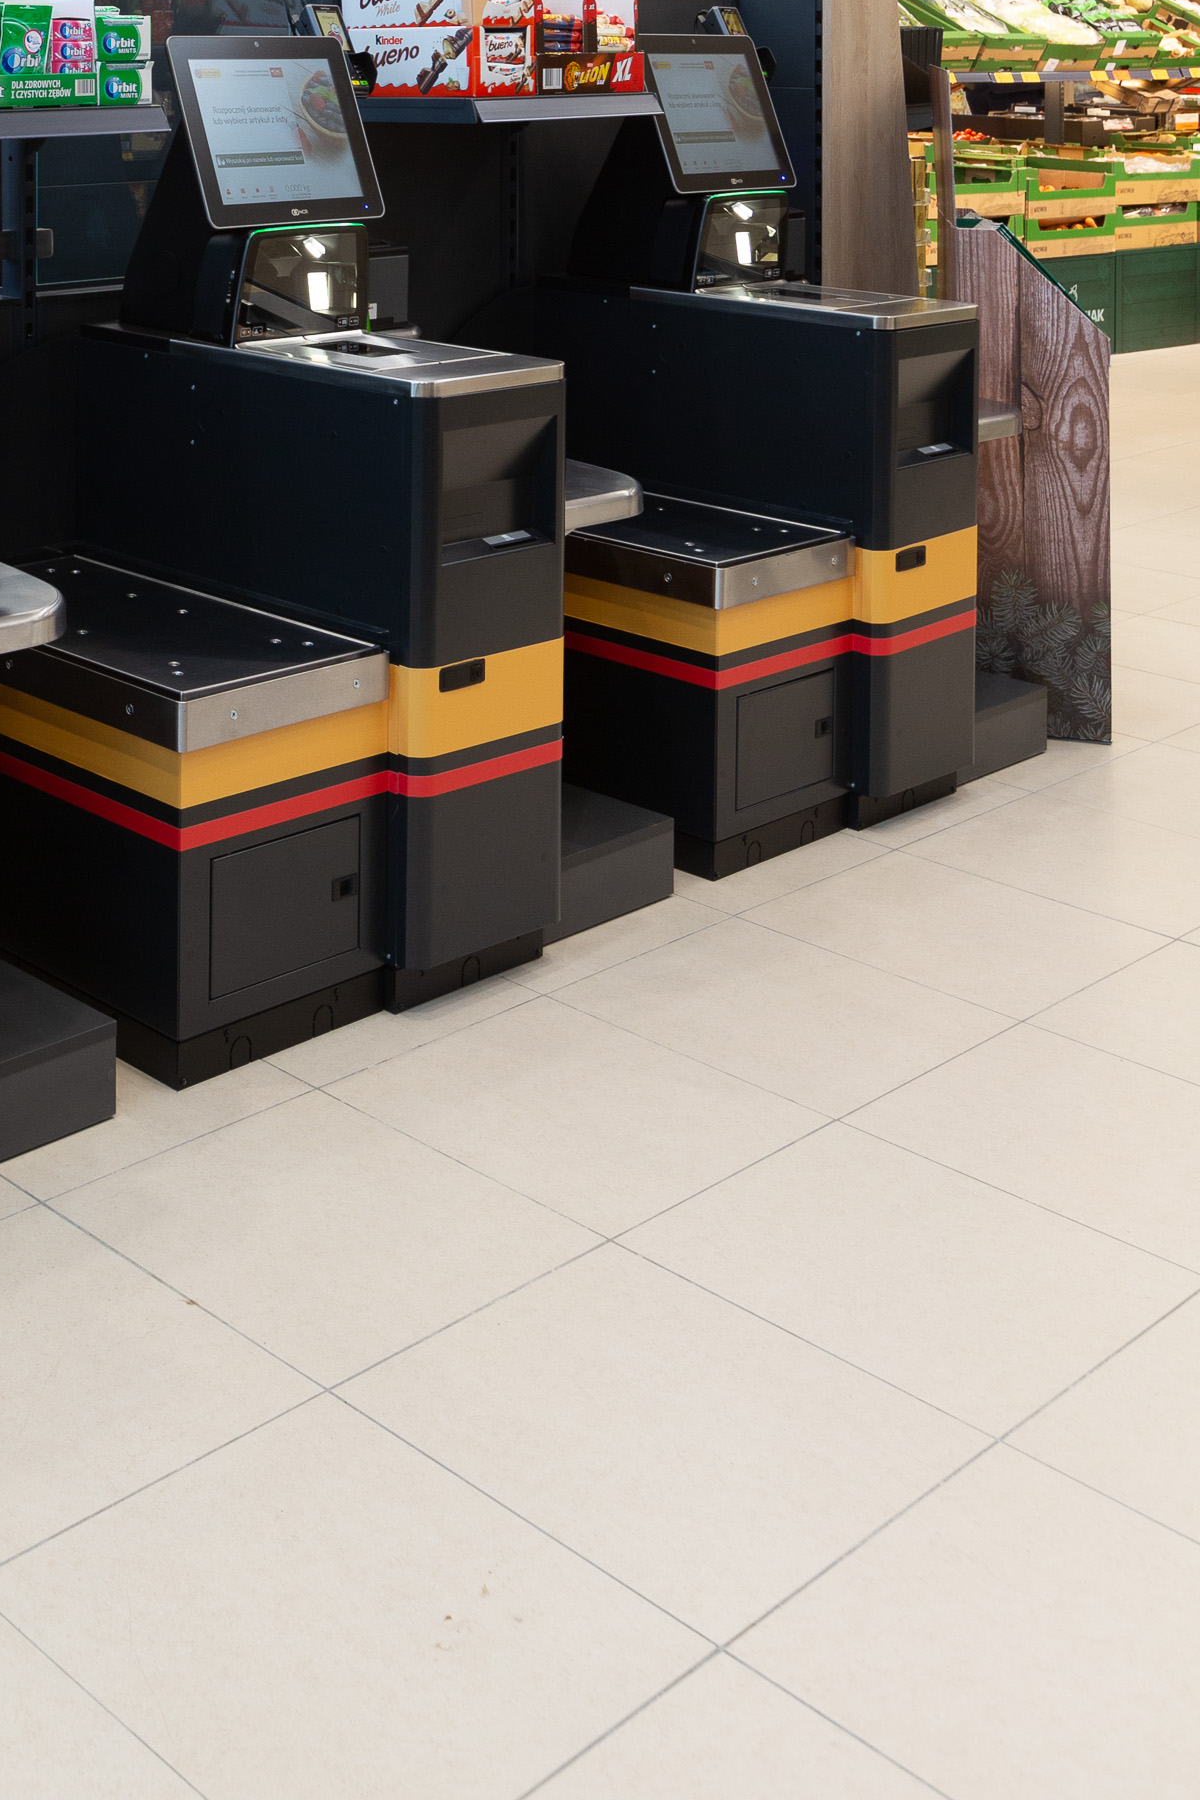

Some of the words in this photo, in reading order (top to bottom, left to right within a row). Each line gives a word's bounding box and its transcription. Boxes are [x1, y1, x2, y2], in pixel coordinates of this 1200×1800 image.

[375, 1, 401, 18] White
[61, 24, 84, 38] Orbit
[103, 35, 136, 53] Orbit
[375, 34, 403, 46] Kinder
[488, 39, 513, 52] bueno
[61, 44, 86, 58] Orbit
[365, 44, 420, 69] ueno
[2, 50, 42, 72] Orbi
[611, 55, 634, 84] XL
[11, 81, 23, 89] DLA
[24, 79, 61, 89] ZDROWYCH
[106, 79, 138, 97] Orbit
[11, 91, 15, 99] I
[16, 89, 47, 99] CZYSTYCH
[48, 87, 72, 99] ZĘBÓW
